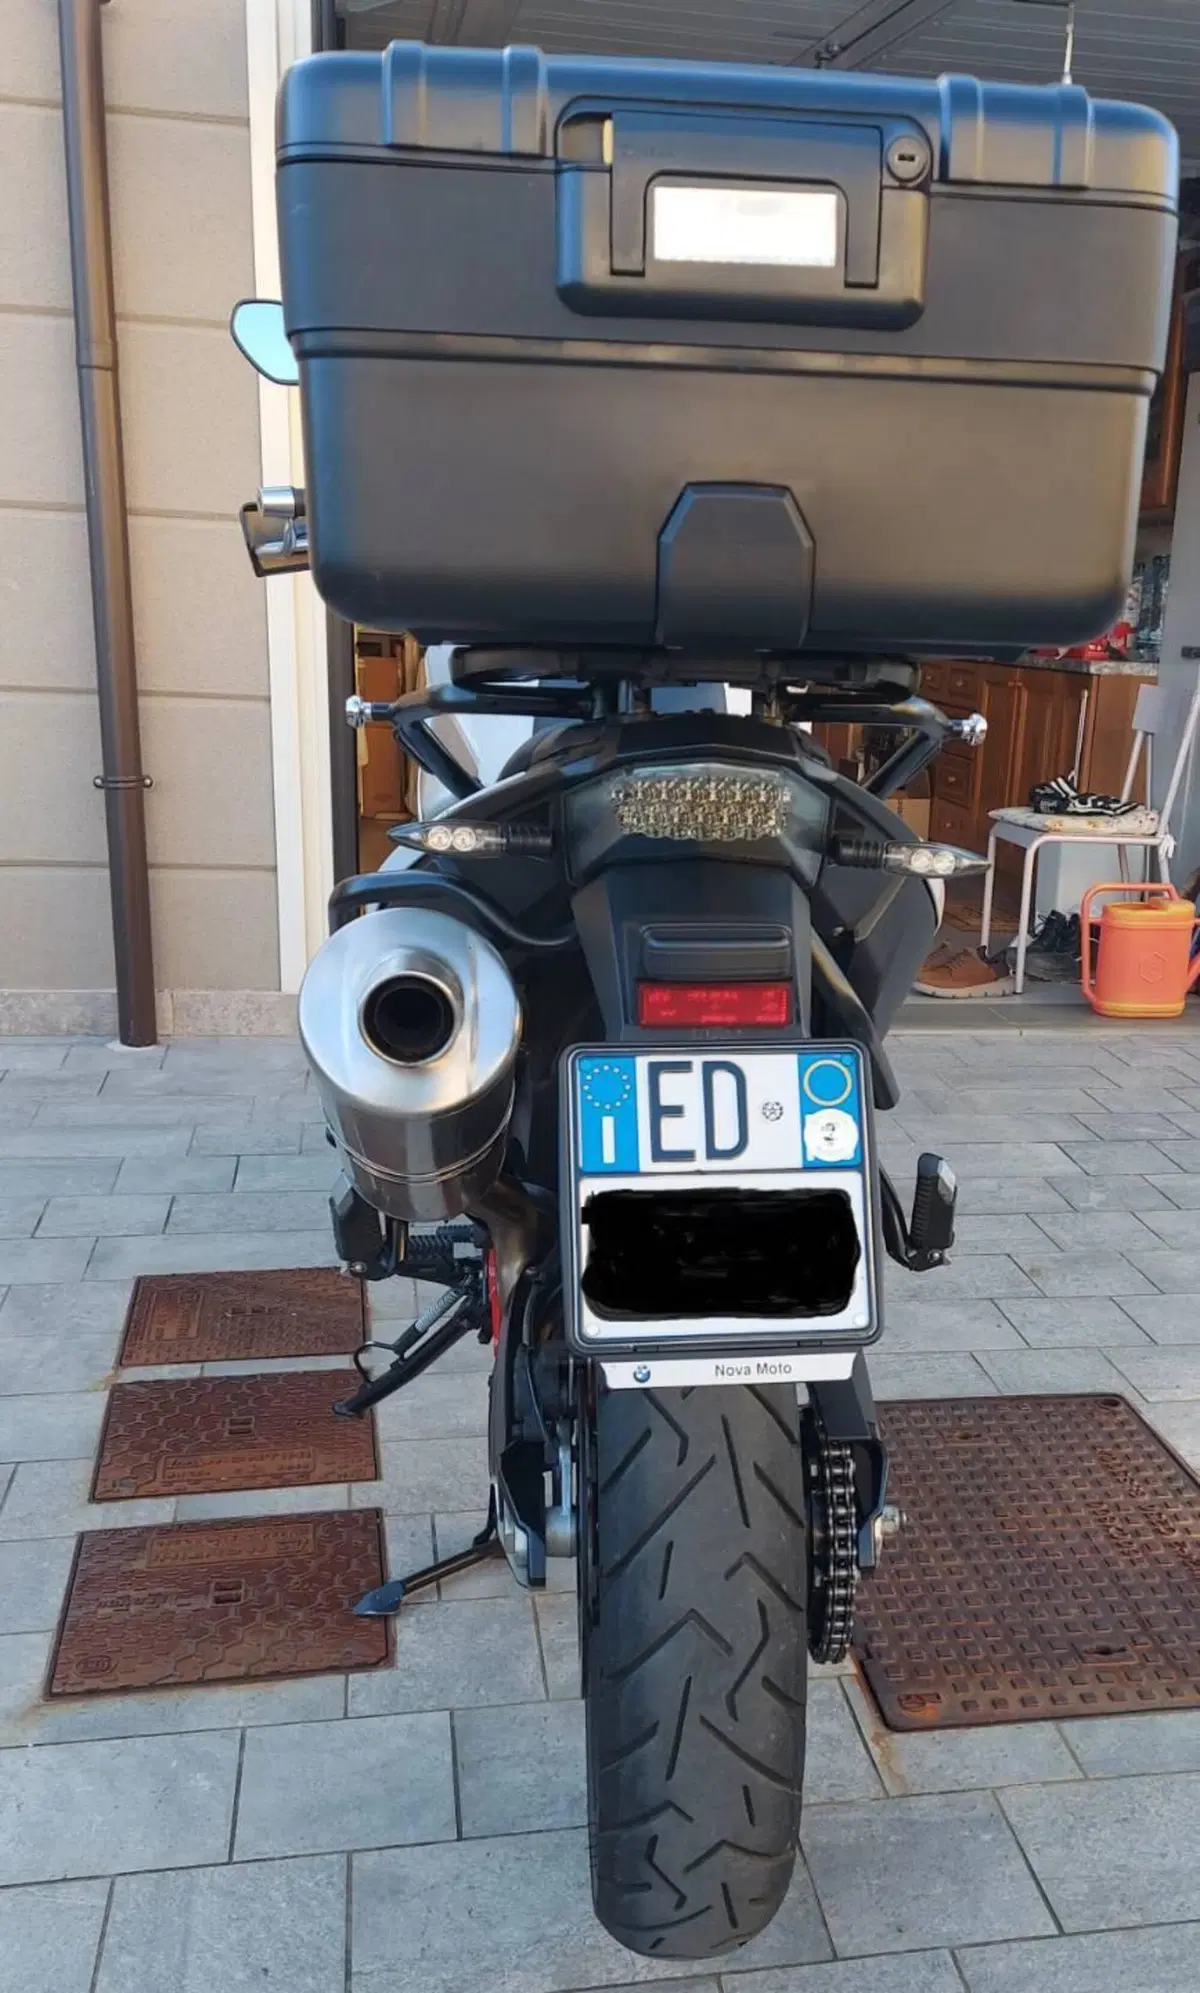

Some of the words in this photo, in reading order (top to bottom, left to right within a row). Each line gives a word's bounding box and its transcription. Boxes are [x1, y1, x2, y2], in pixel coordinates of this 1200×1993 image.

[648, 1061, 749, 1162] ED
[715, 1364, 751, 1377] Nova
[756, 1362, 792, 1375] Moto
